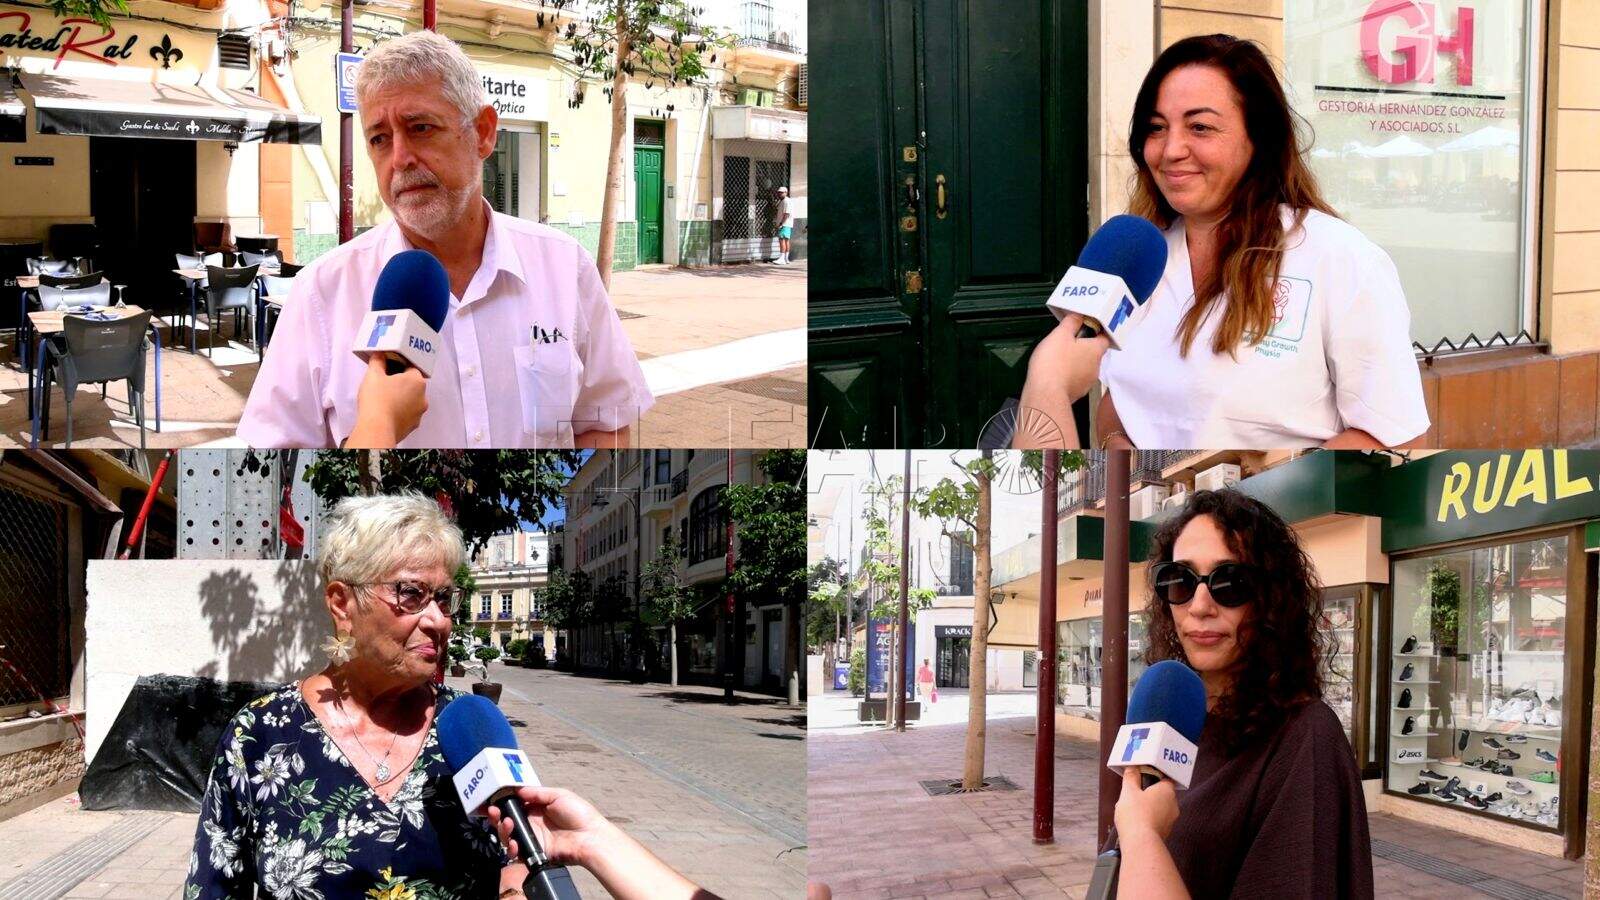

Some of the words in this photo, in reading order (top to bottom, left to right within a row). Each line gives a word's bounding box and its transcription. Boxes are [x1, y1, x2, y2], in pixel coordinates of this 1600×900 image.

[1370, 119, 1377, 131] Y
[1062, 285, 1099, 297] FARO
[408, 335, 432, 353] FARO
[1437, 448, 1594, 523] RUAL
[945, 627, 971, 636] KRACK
[1163, 747, 1188, 765] FARO
[463, 768, 484, 800] FARO
